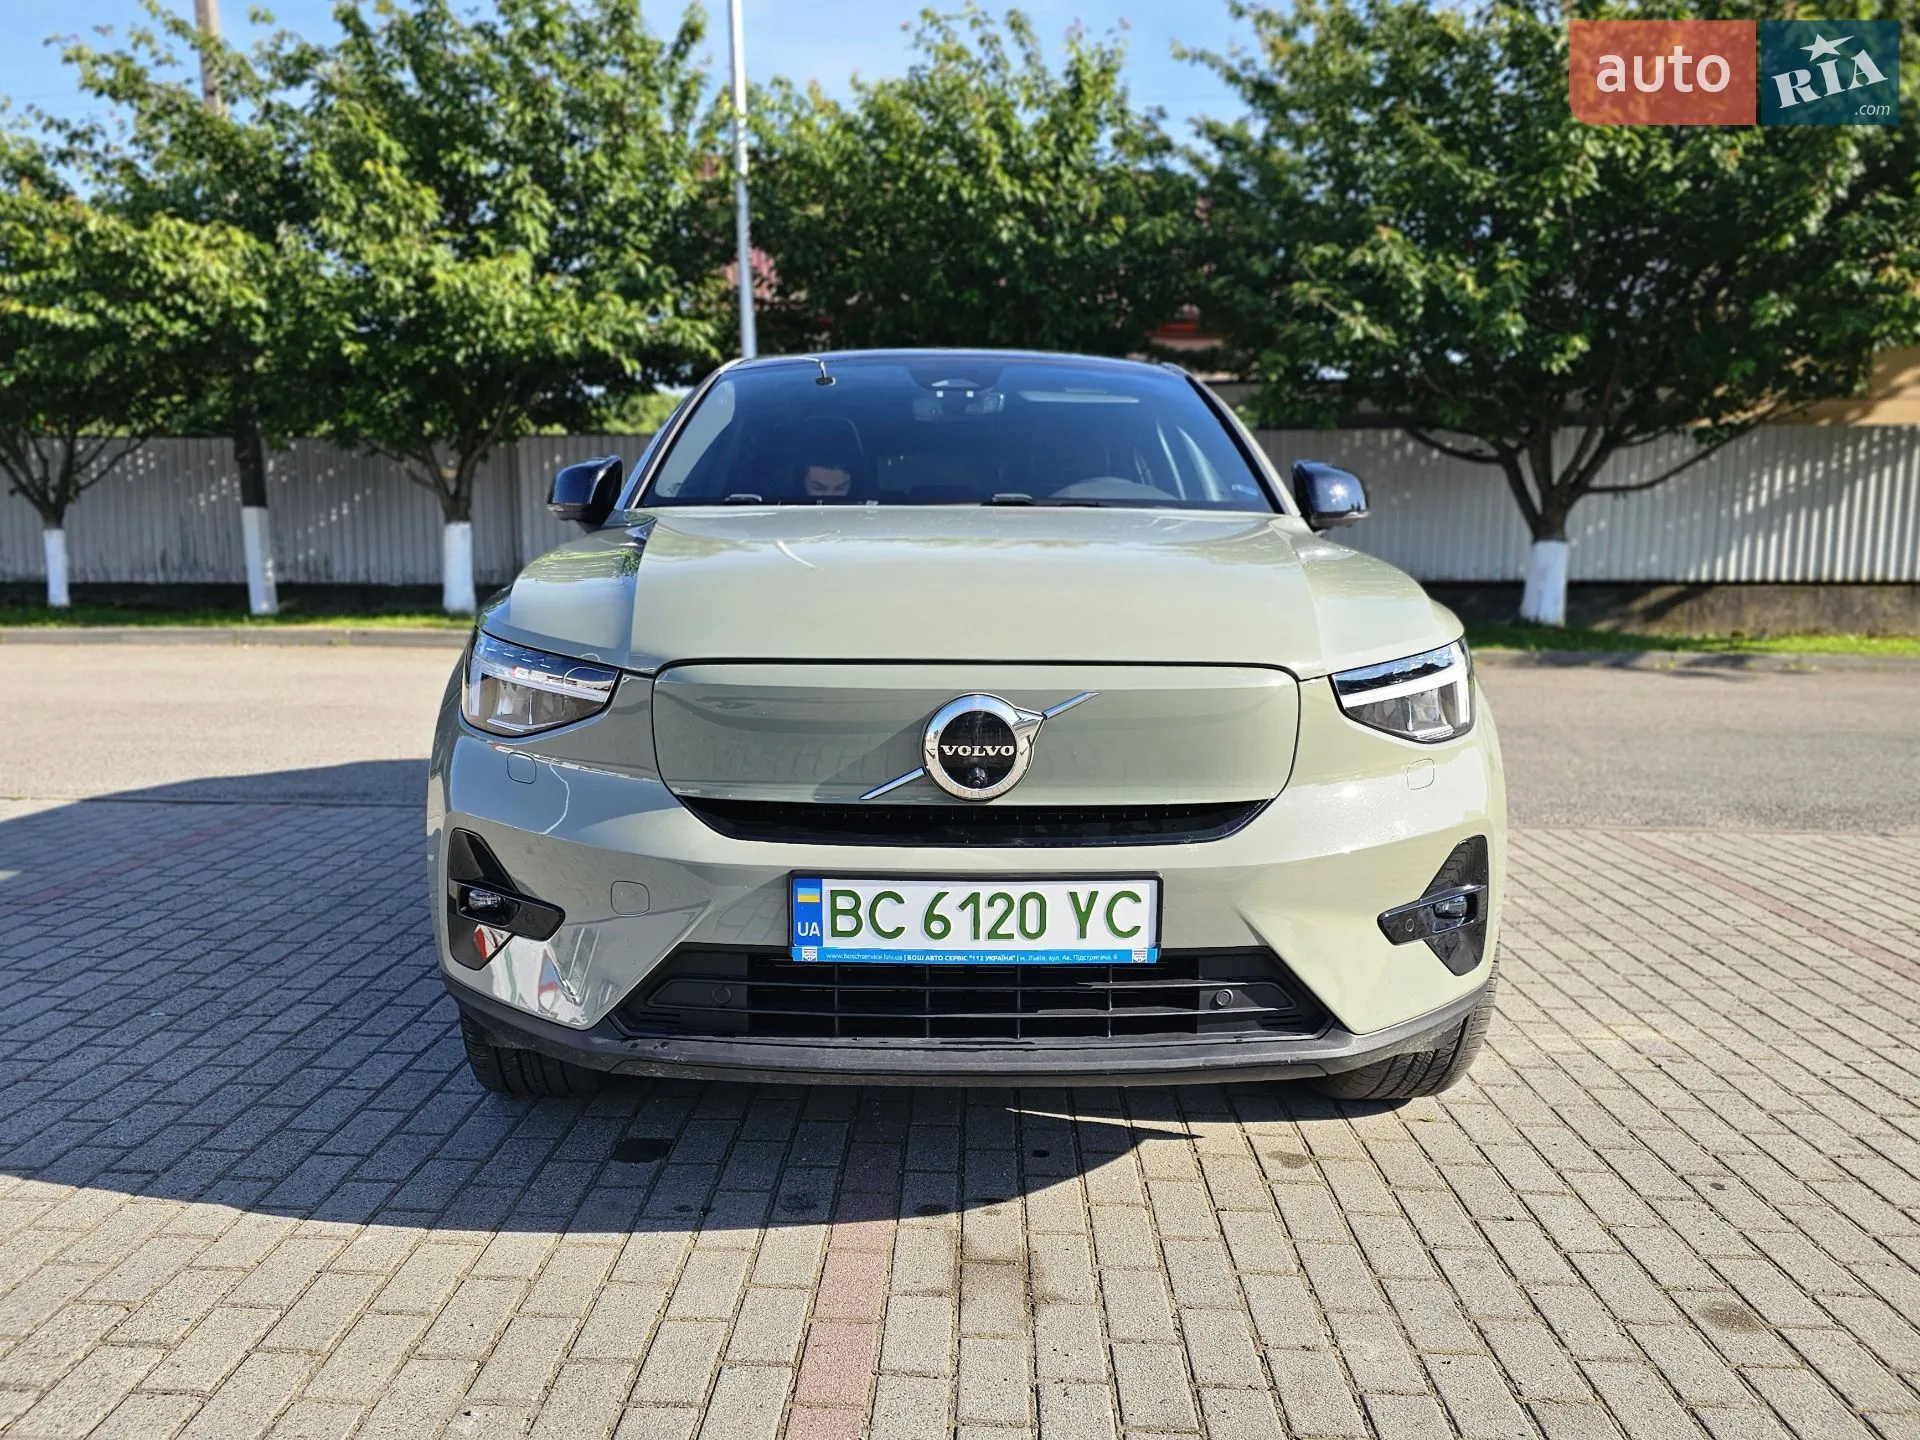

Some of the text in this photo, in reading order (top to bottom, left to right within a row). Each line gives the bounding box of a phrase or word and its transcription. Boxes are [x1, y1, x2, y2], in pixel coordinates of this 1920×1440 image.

[940, 745, 1015, 757] VOLVO
[829, 889, 1142, 940] BC 6120 YC
[797, 921, 821, 937] UA
